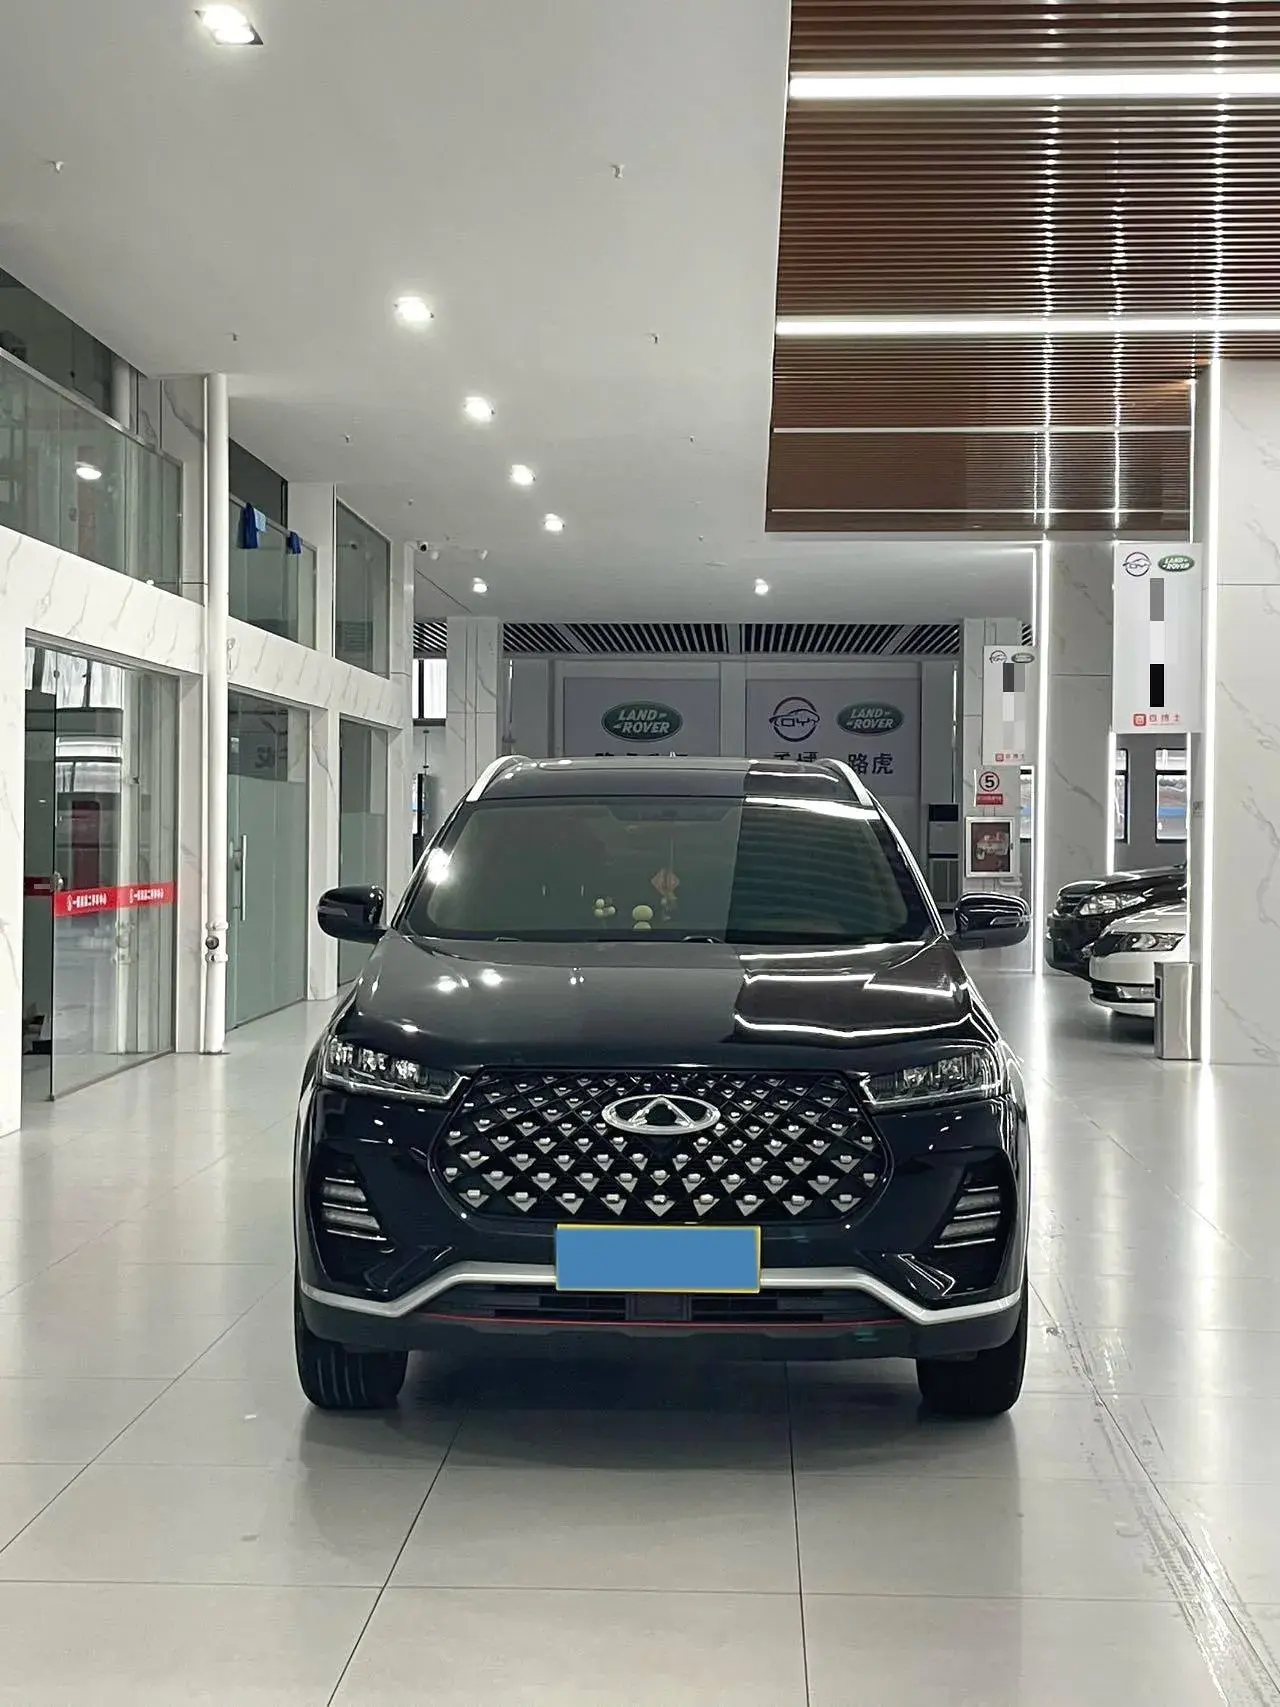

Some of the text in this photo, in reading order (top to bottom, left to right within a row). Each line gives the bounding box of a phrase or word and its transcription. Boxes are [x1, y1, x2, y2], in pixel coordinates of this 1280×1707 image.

[618, 710, 658, 723] LAND
[850, 708, 883, 718] LAND
[623, 722, 671, 734] ROVER
[853, 718, 894, 729] ROVER
[848, 752, 894, 775] 路虎
[985, 775, 995, 788] 5
